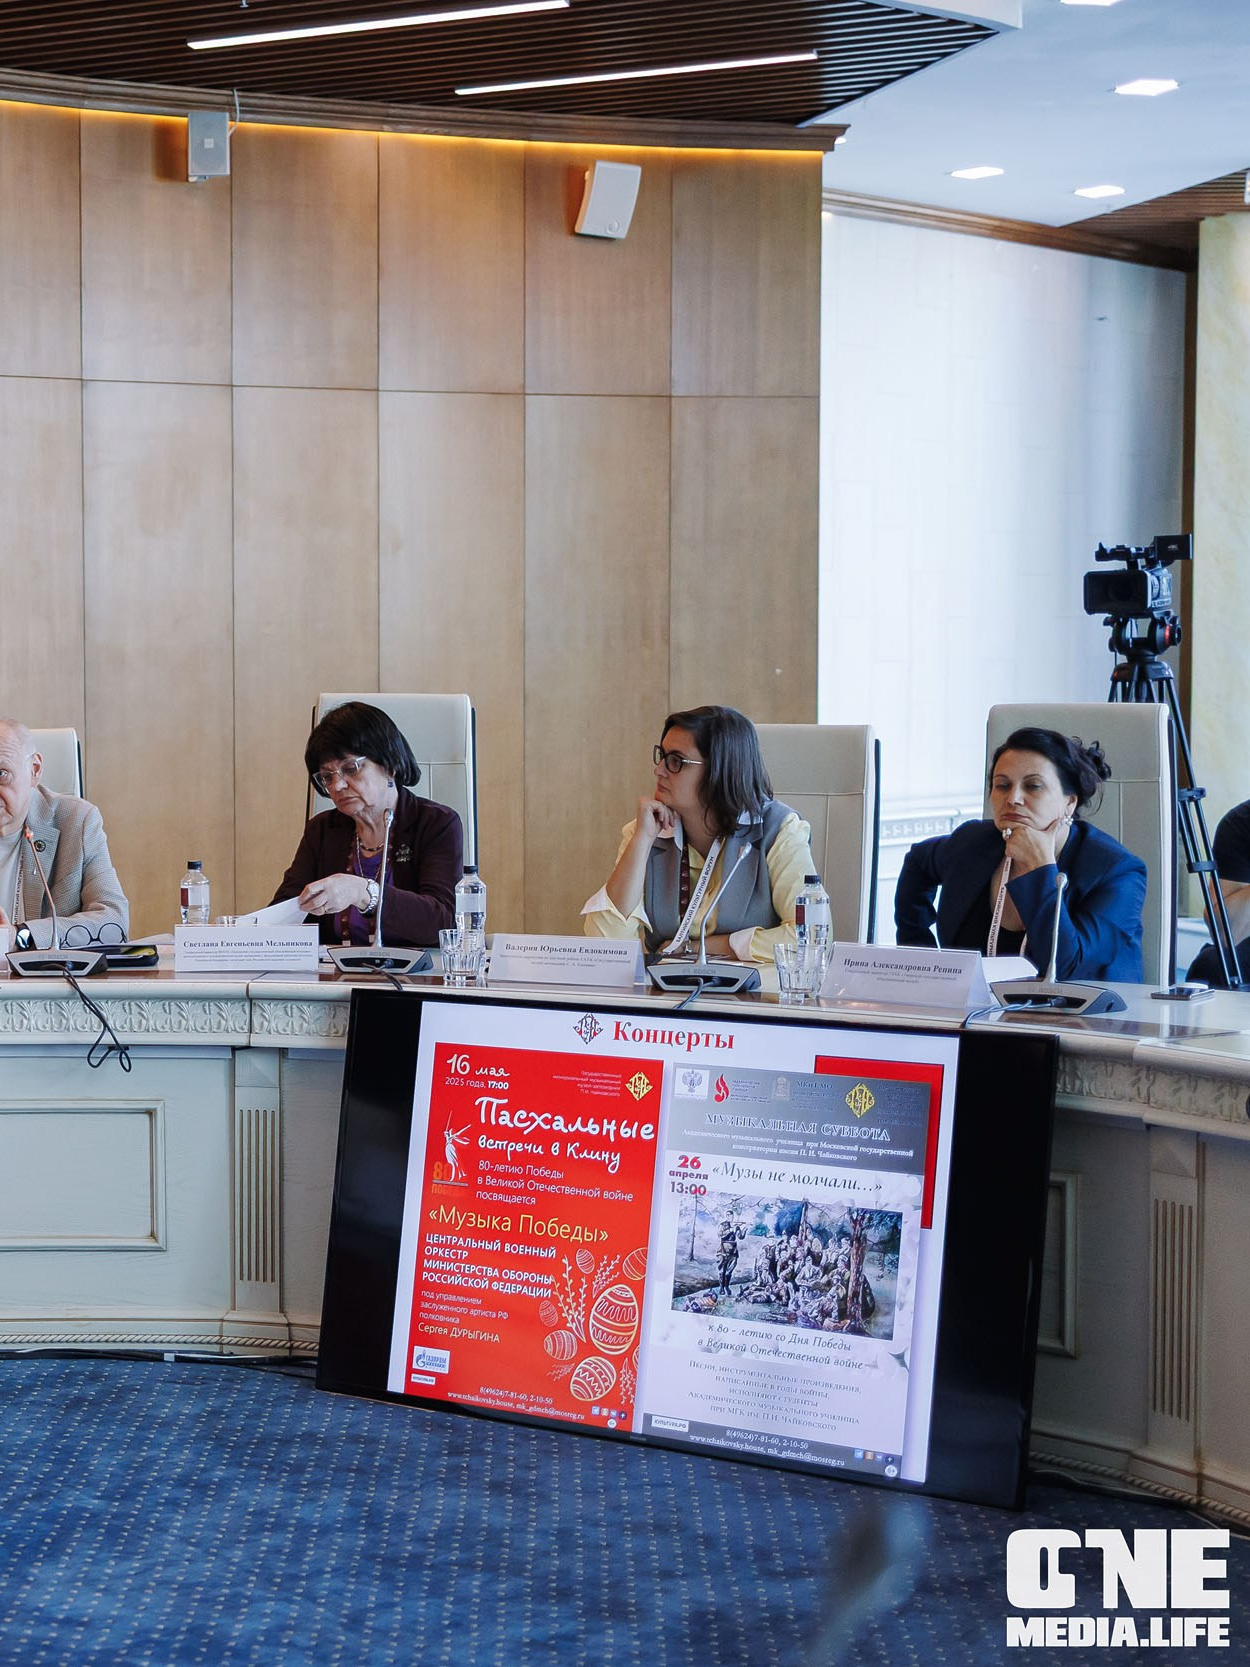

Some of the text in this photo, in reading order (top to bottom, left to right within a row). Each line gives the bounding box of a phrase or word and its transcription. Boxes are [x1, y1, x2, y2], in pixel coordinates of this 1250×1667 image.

[505, 943, 538, 953] Валерия
[613, 1021, 735, 1052] Концерты
[446, 1054, 510, 1077] 16 мая
[445, 1077, 465, 1087] 2025
[487, 1081, 510, 1091] 17:00
[474, 1096, 655, 1142] Пасхальные
[705, 1112, 891, 1142] МУЗЫКАЛЬНАЯ СУББОТА
[478, 1134, 621, 1173] встречи в Клину
[678, 1154, 702, 1170] 26
[478, 1160, 565, 1180] 80-летию Победы
[669, 1169, 709, 1181] апреля
[711, 1161, 764, 1182] «Музы
[768, 1171, 786, 1183] не
[476, 1190, 536, 1206] посвящается
[477, 1175, 633, 1202] в Великой Отечественной войне
[670, 1181, 707, 1196] 13:00
[429, 1204, 609, 1244] «Музыка Победы»
[424, 1246, 468, 1260] ОРКЕСТР
[425, 1233, 556, 1259] ЦЕНТРАЛЬНЫЙ ВОЕННЫЙ
[423, 1258, 552, 1285] МИНИСТЕРСТВА ОБОРОНЫ
[422, 1271, 551, 1299] РОССИЙСКОЙ ФЕДЕРАЦИИ
[497, 1311, 509, 1321] РФ
[417, 1322, 500, 1343] Сергея ДУРЫГИНА
[708, 1323, 851, 1352] к 80 летию со Дня Победы
[697, 1337, 863, 1371] в Великой Отечественной войне
[783, 1437, 809, 1450] 2-10-50
